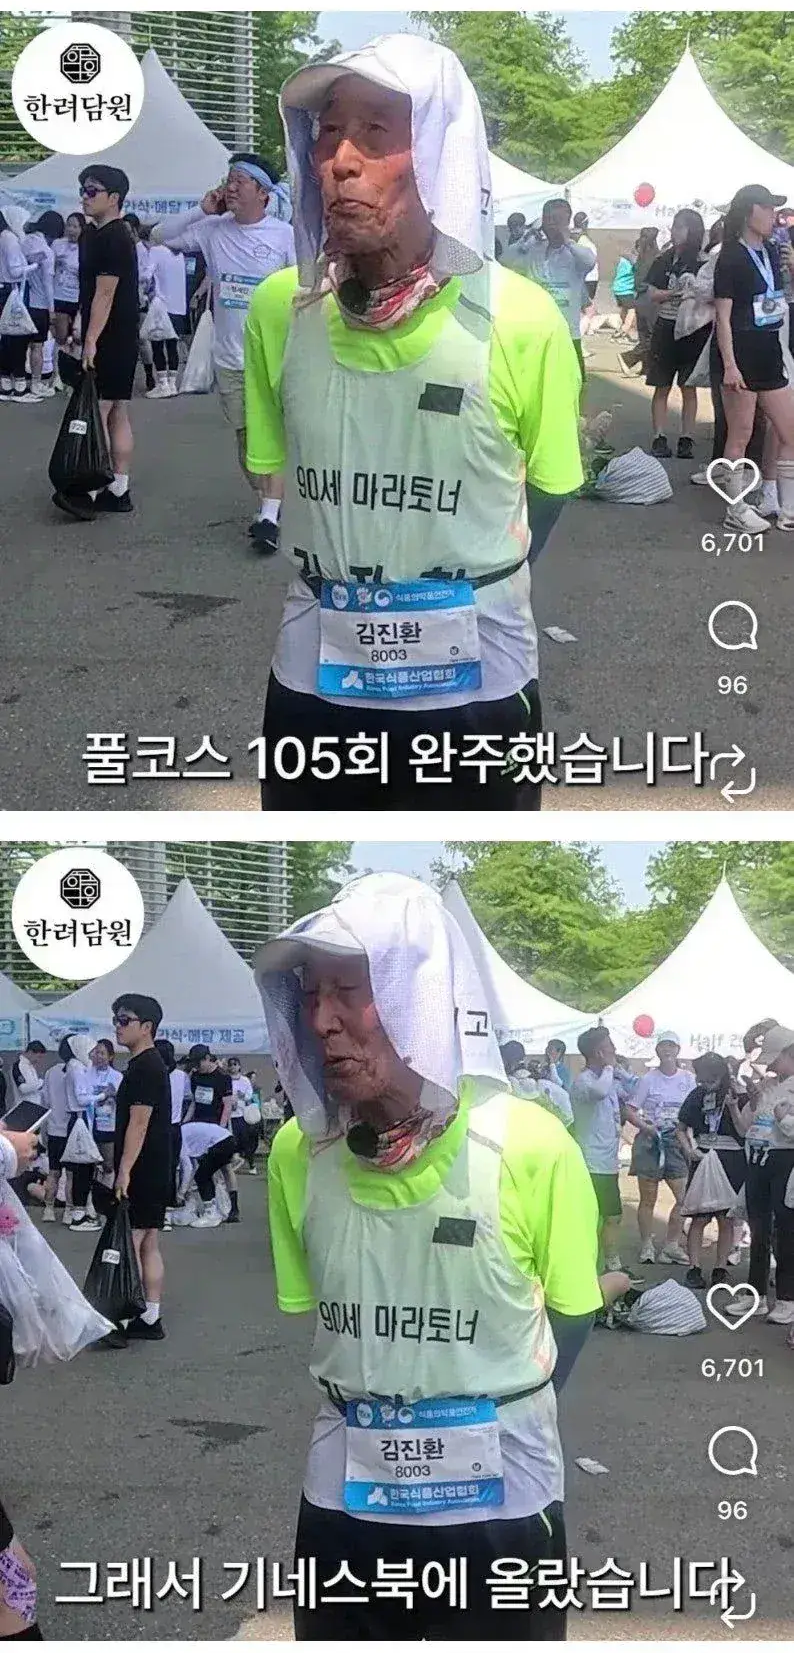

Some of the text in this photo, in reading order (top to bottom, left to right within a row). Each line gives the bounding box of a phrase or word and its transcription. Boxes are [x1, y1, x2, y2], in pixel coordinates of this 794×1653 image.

[296, 465, 462, 516] 90세 마라토너
[355, 621, 421, 645] 김진환
[371, 649, 407, 663] 8003
[319, 1301, 479, 1345] 90세 마라토너
[380, 1437, 445, 1461] 김진환
[395, 1464, 431, 1478] 8003
